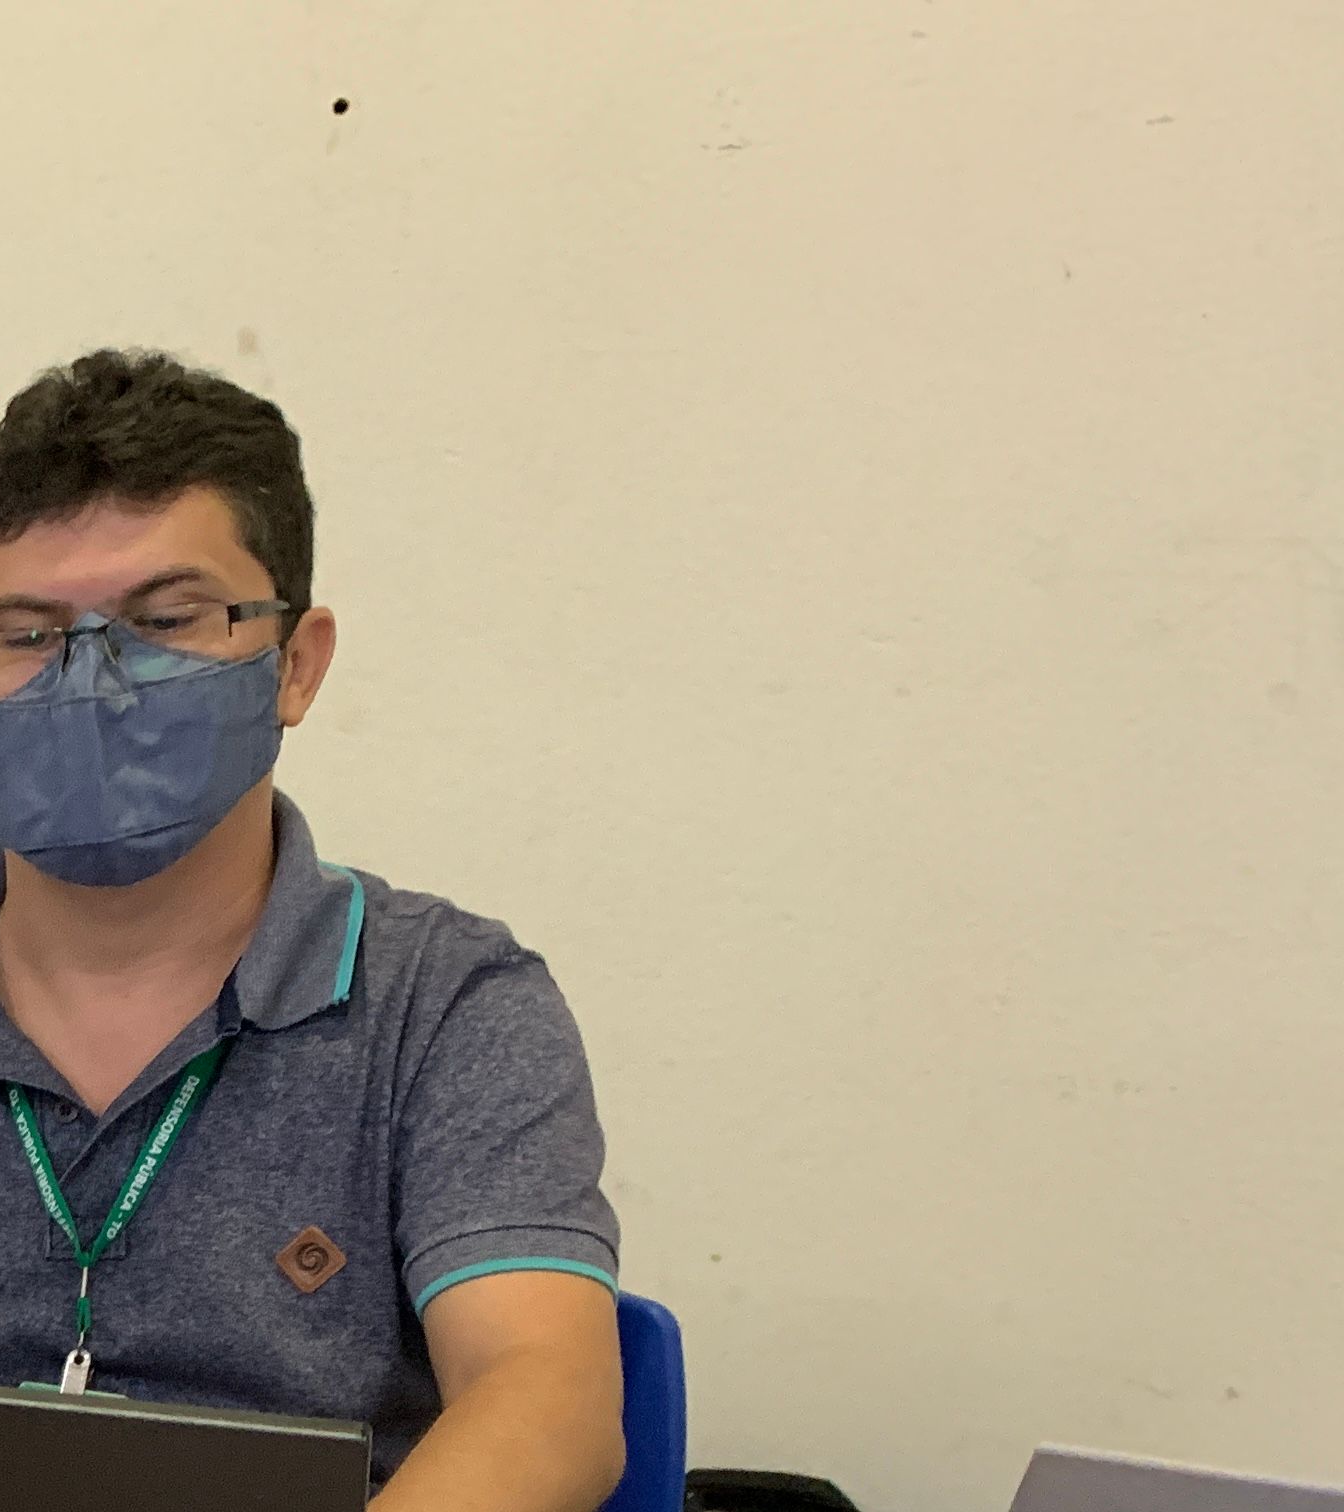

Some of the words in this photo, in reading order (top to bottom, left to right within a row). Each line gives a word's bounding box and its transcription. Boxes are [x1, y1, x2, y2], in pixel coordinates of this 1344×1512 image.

[149, 1075, 200, 1155] DEFENSORIA
[120, 1155, 157, 1211] PÚBLICA
[106, 1220, 123, 1240] TO
